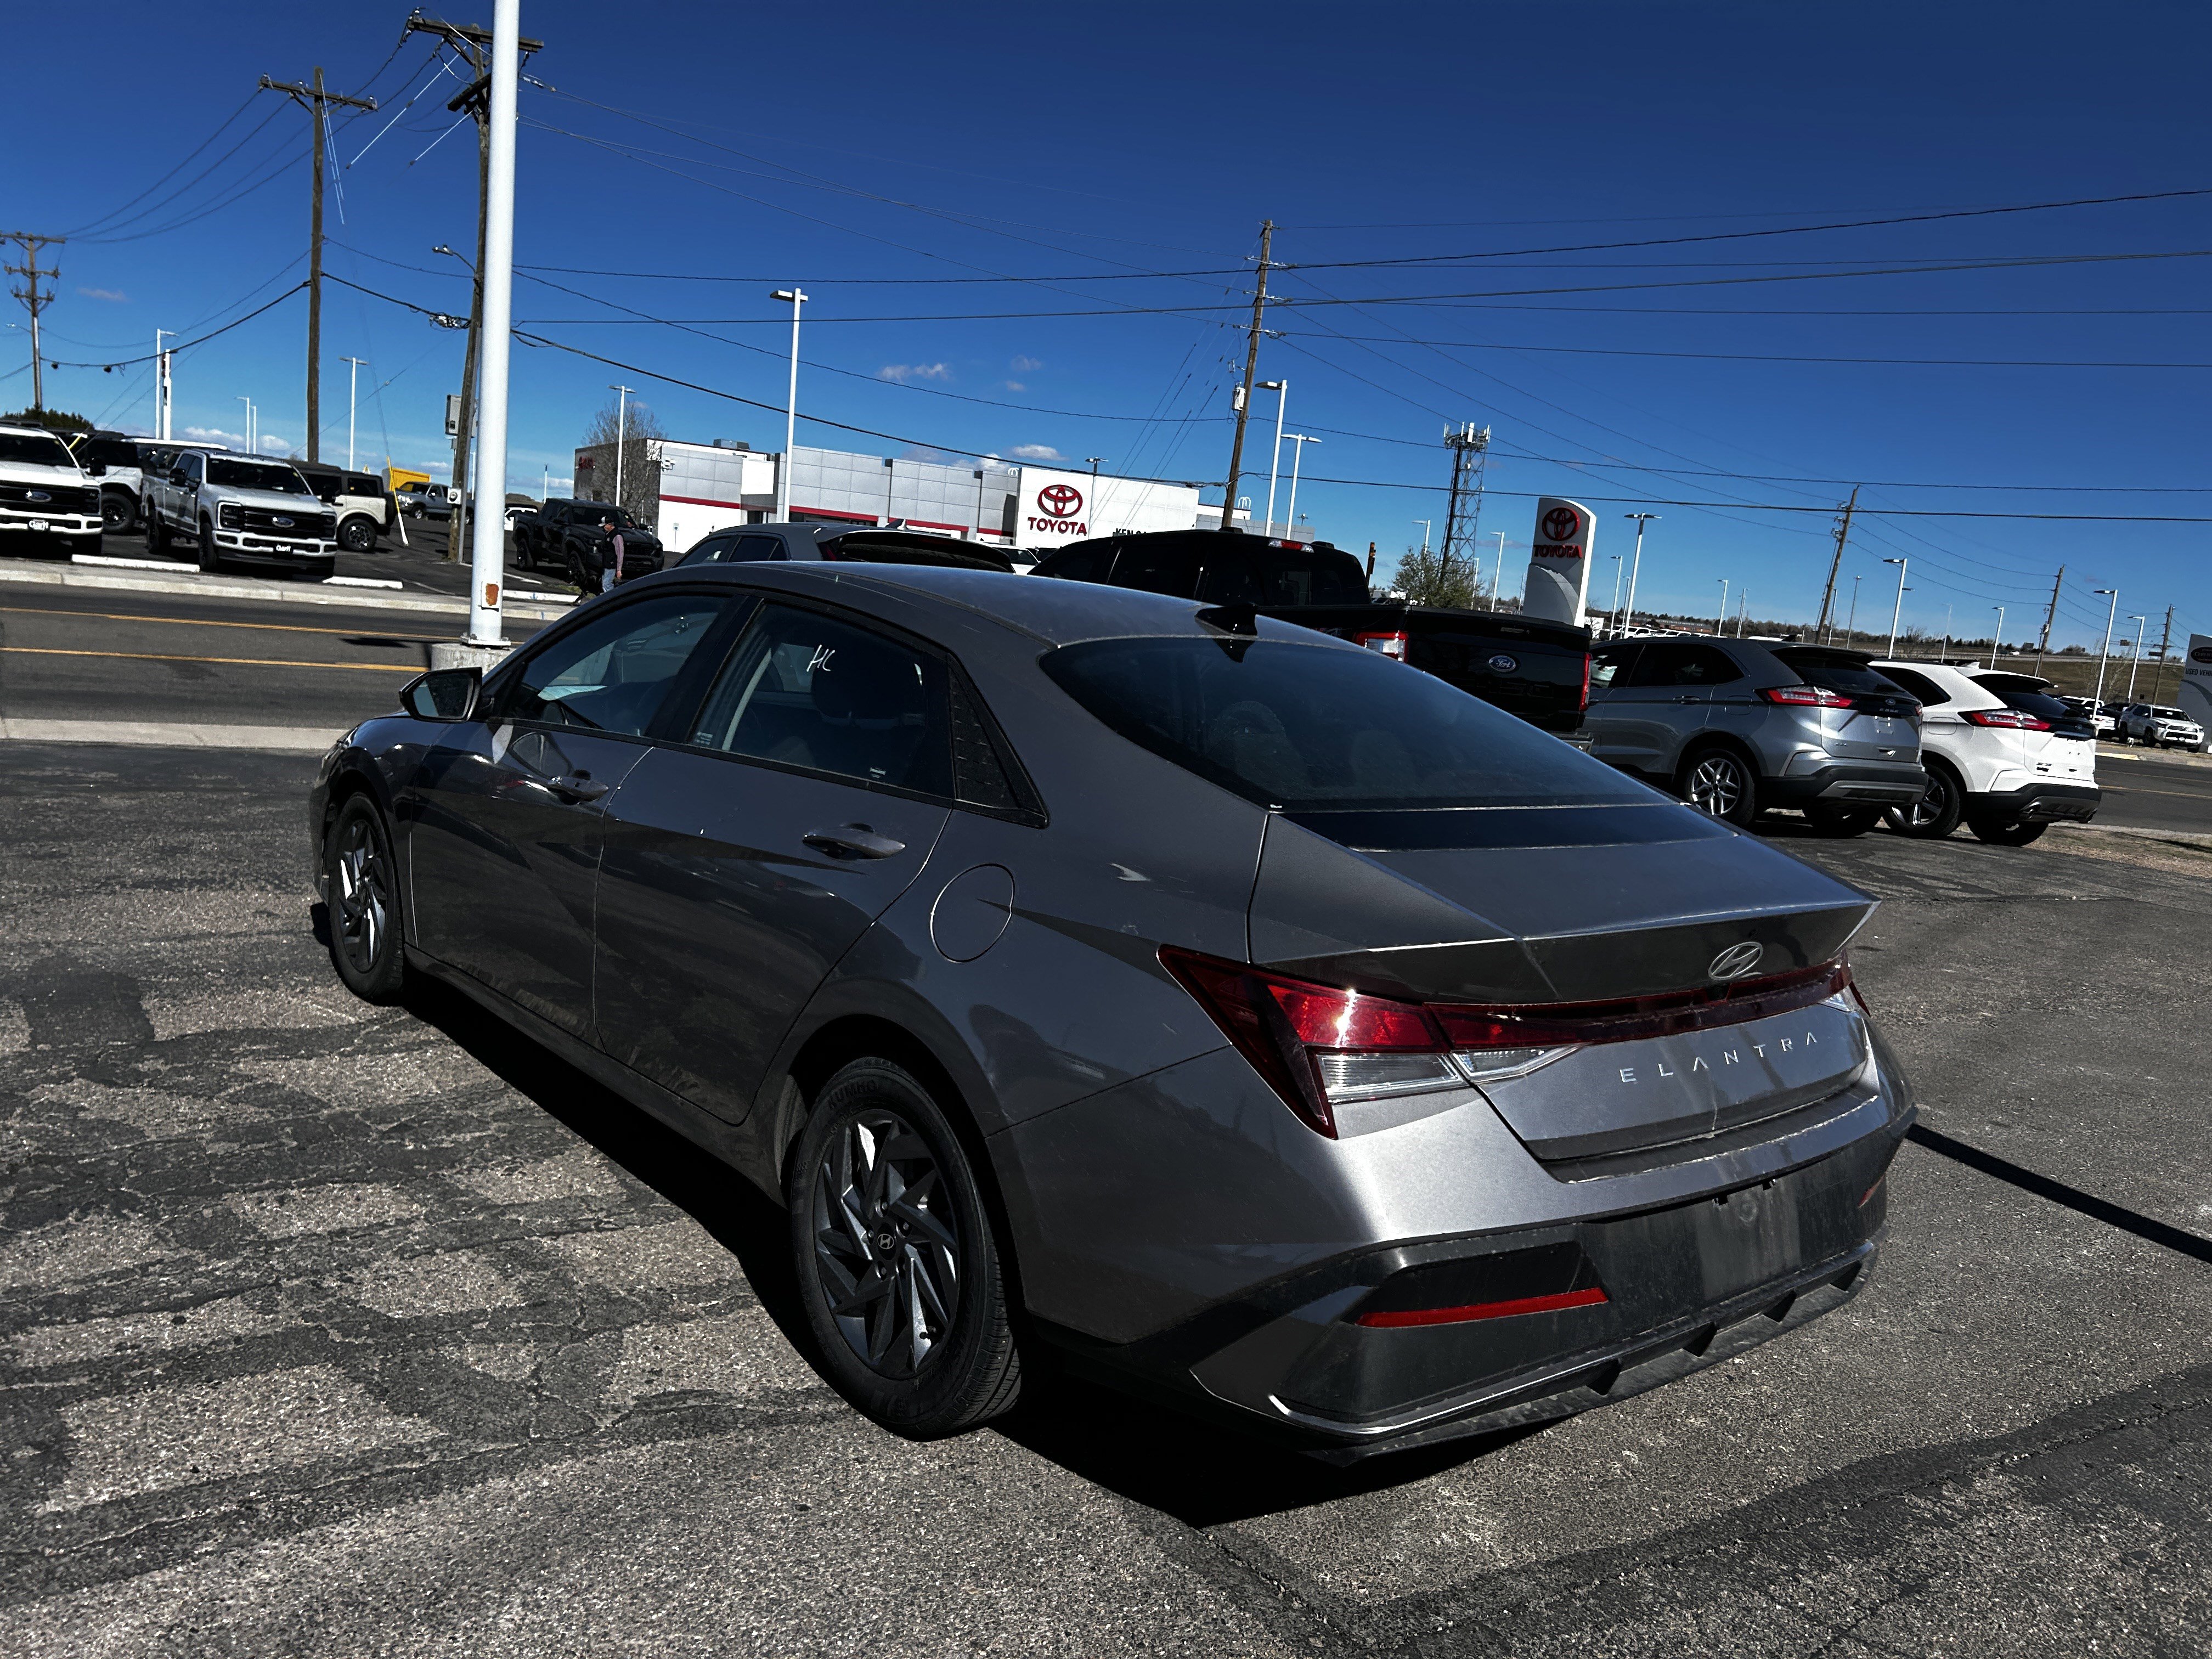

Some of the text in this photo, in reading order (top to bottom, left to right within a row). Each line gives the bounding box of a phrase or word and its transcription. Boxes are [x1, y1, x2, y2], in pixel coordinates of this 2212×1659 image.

[1027, 516, 1087, 537] TOYOTA
[1533, 544, 1583, 558] TOYOTA
[1619, 1032, 1817, 1083] ELANTRA
[827, 1079, 877, 1109] KUMHO
